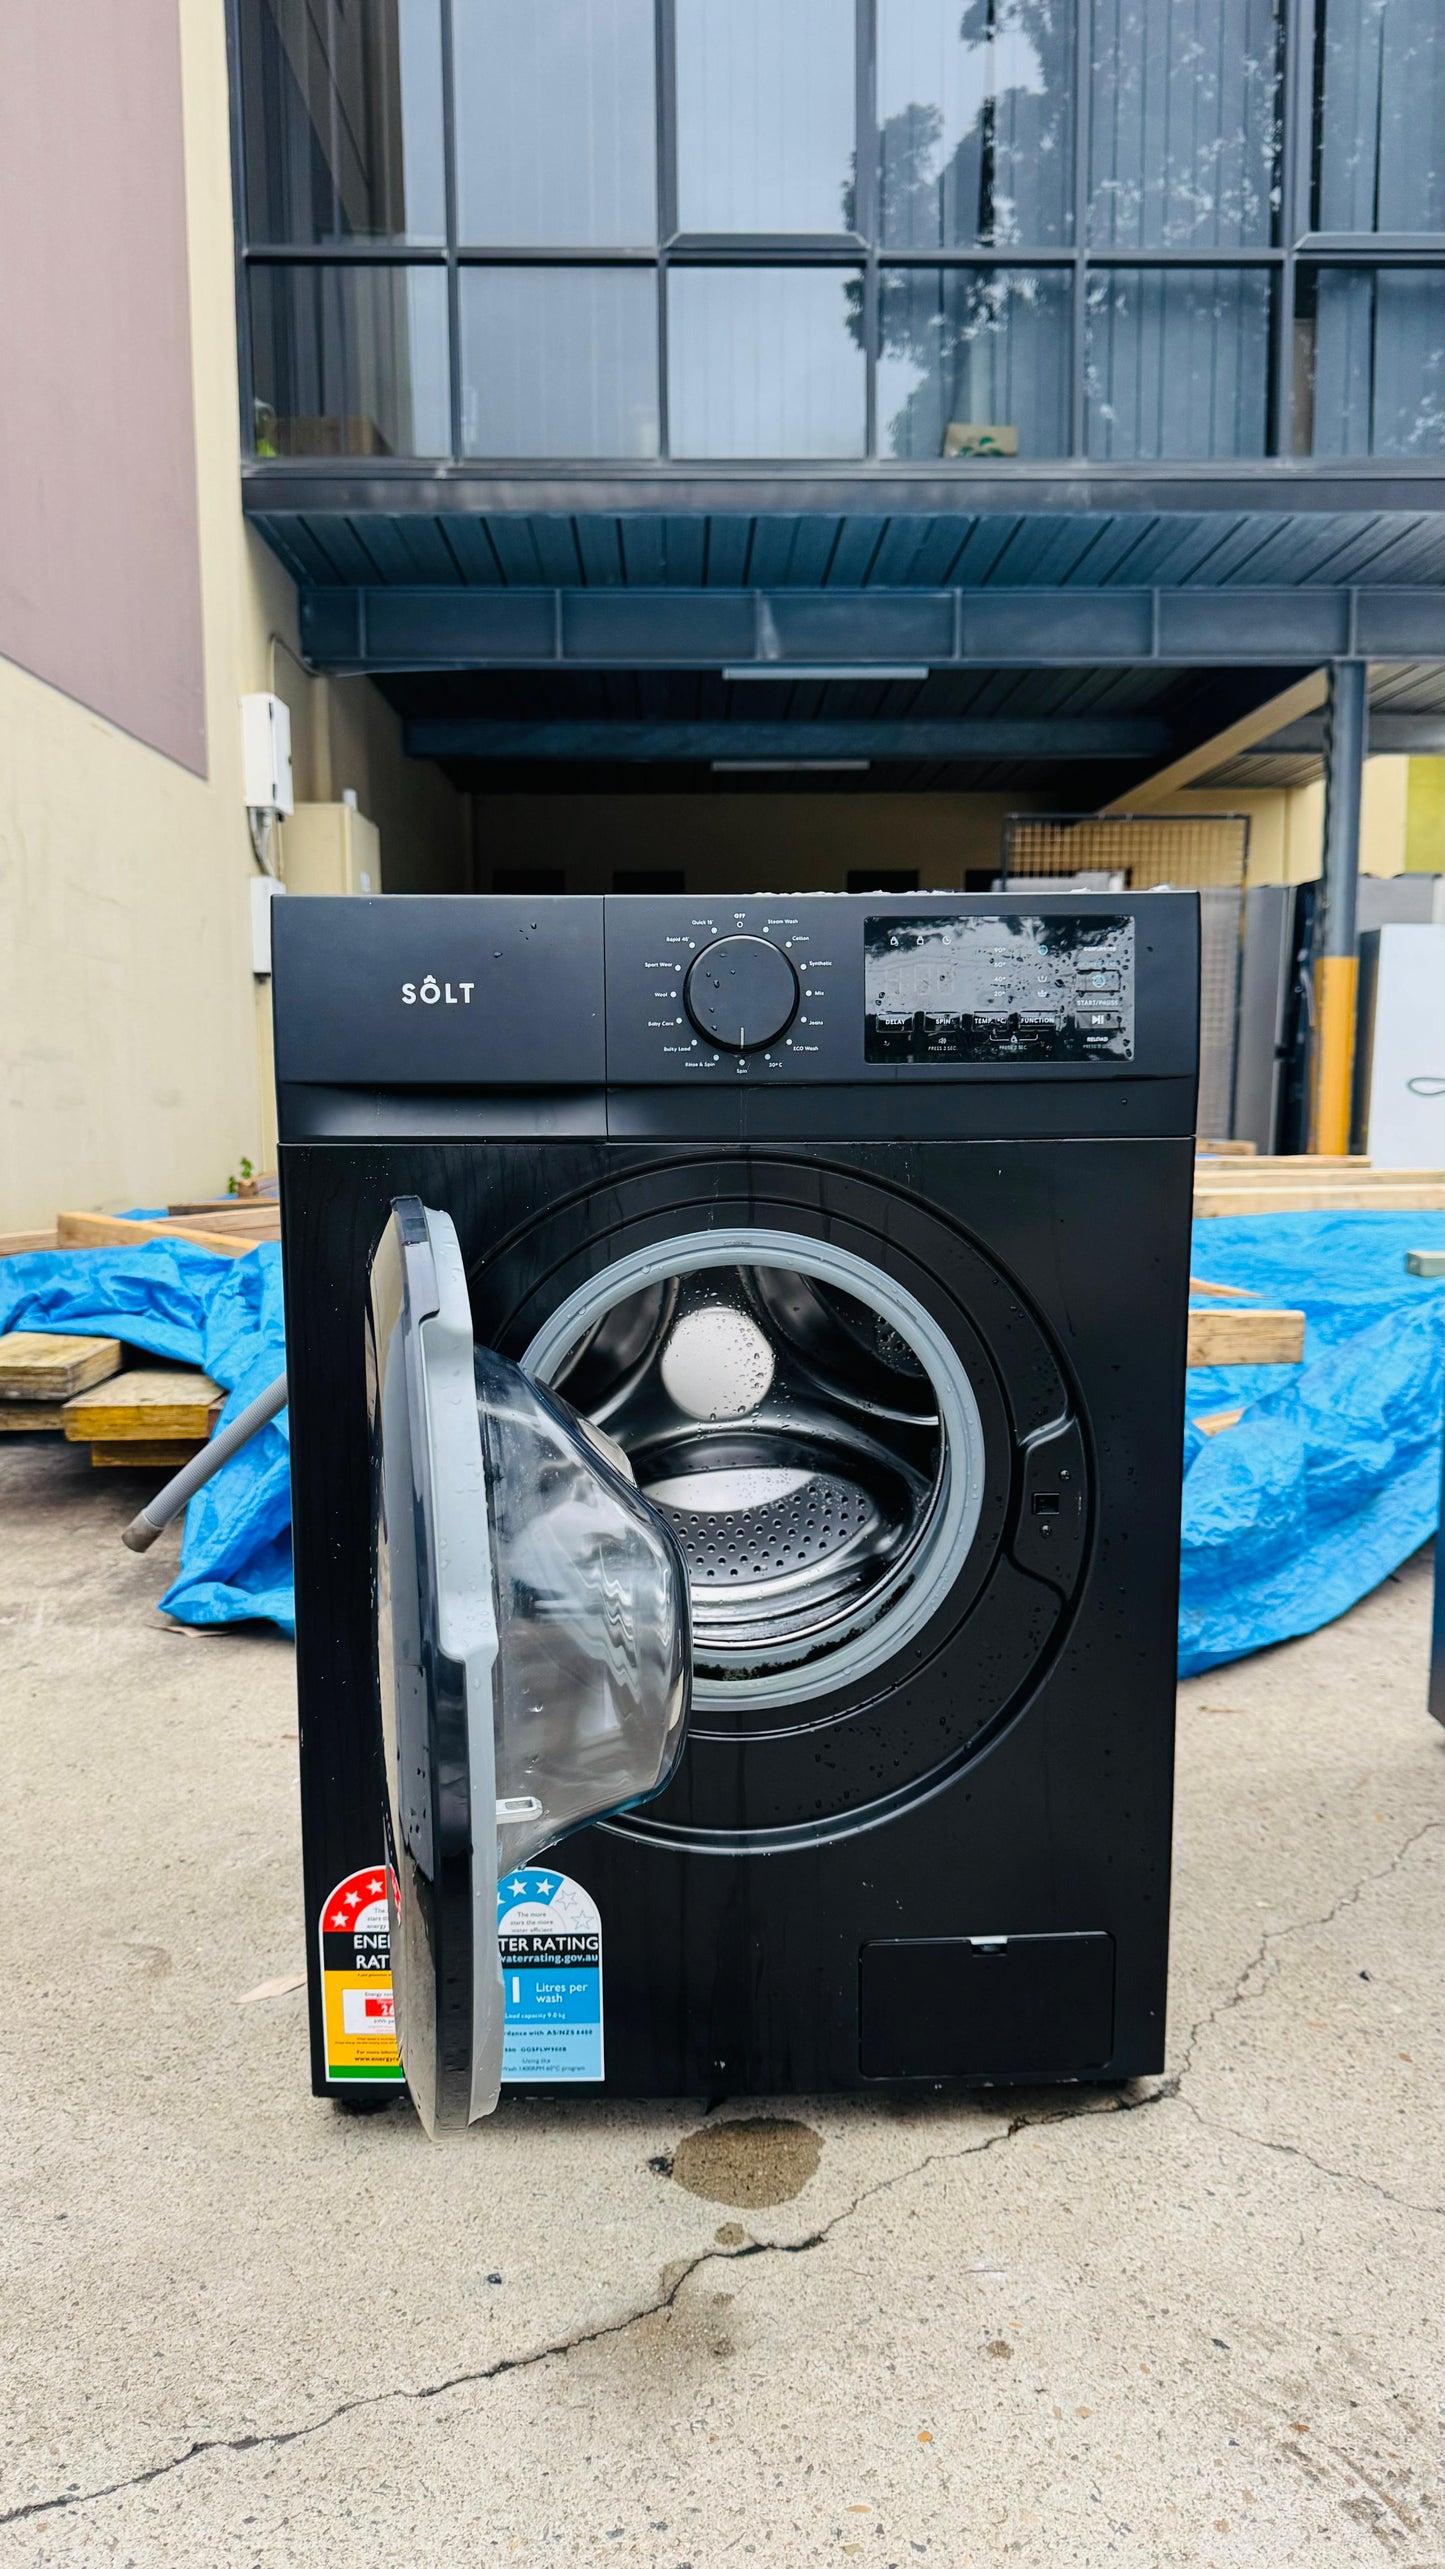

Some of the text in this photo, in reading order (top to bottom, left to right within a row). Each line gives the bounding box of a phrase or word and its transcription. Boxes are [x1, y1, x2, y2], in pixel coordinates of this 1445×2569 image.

[402, 975, 475, 1004] SÔLT
[533, 1936, 598, 1951] RATING
[536, 1983, 588, 1994] Litres per
[536, 1993, 562, 2003] wash
[558, 2012, 566, 2020] kg
